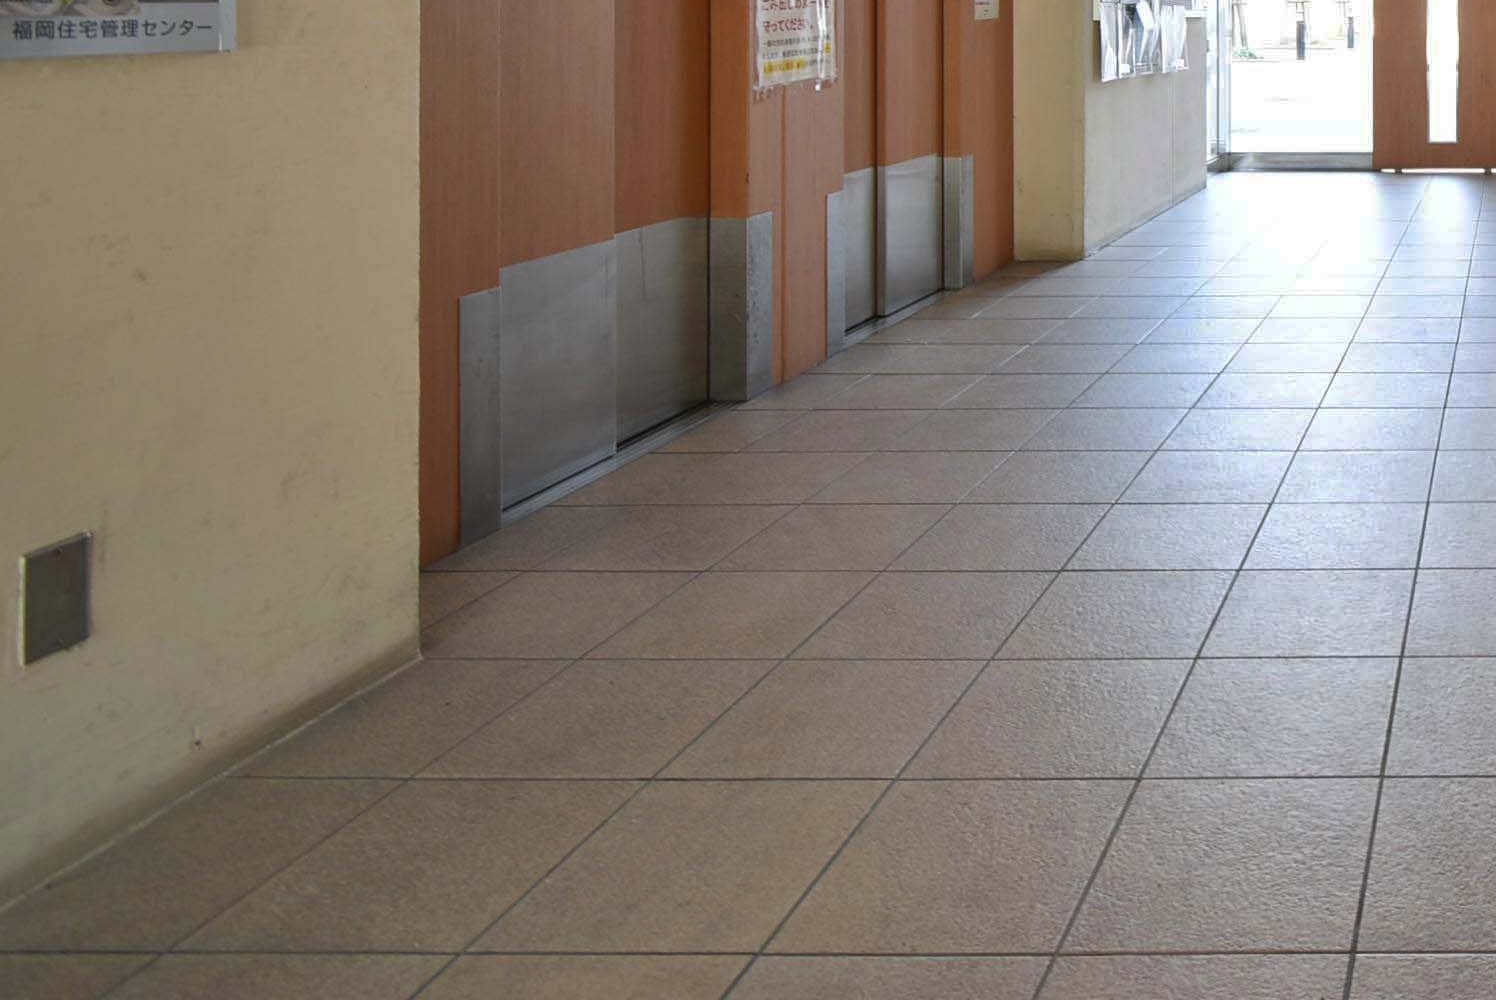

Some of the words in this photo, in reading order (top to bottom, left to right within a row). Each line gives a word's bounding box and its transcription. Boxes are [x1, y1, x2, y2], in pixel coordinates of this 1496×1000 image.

[13, 18, 212, 41] 福岡住宅管理センター
